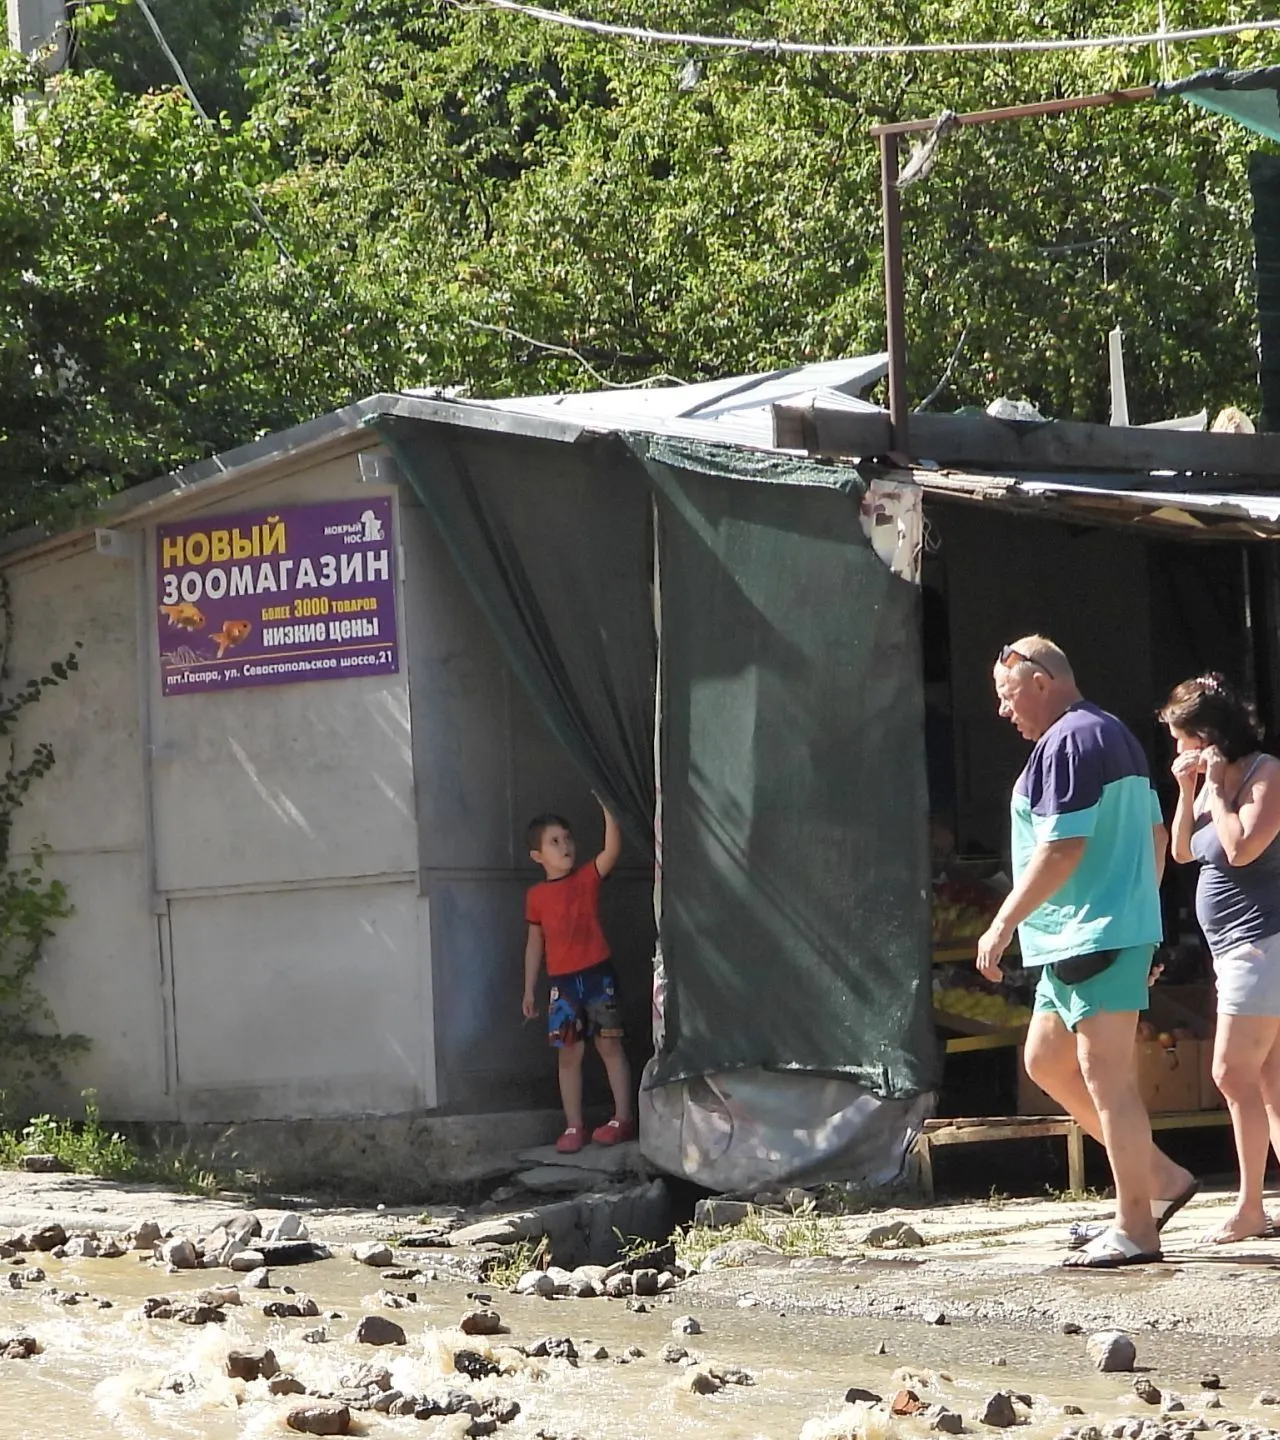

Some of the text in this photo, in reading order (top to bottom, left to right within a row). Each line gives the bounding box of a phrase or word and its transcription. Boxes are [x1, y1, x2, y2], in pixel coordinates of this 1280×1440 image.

[163, 516, 286, 568] НОВЫЙ
[343, 534, 362, 544] НОС
[163, 550, 389, 604] ЗООМАГАЗИН
[261, 597, 377, 621] БОЛЕЕ 3000 ТОВАРОВ
[224, 669, 240, 681] ул.
[243, 659, 336, 676] Севастопольское
